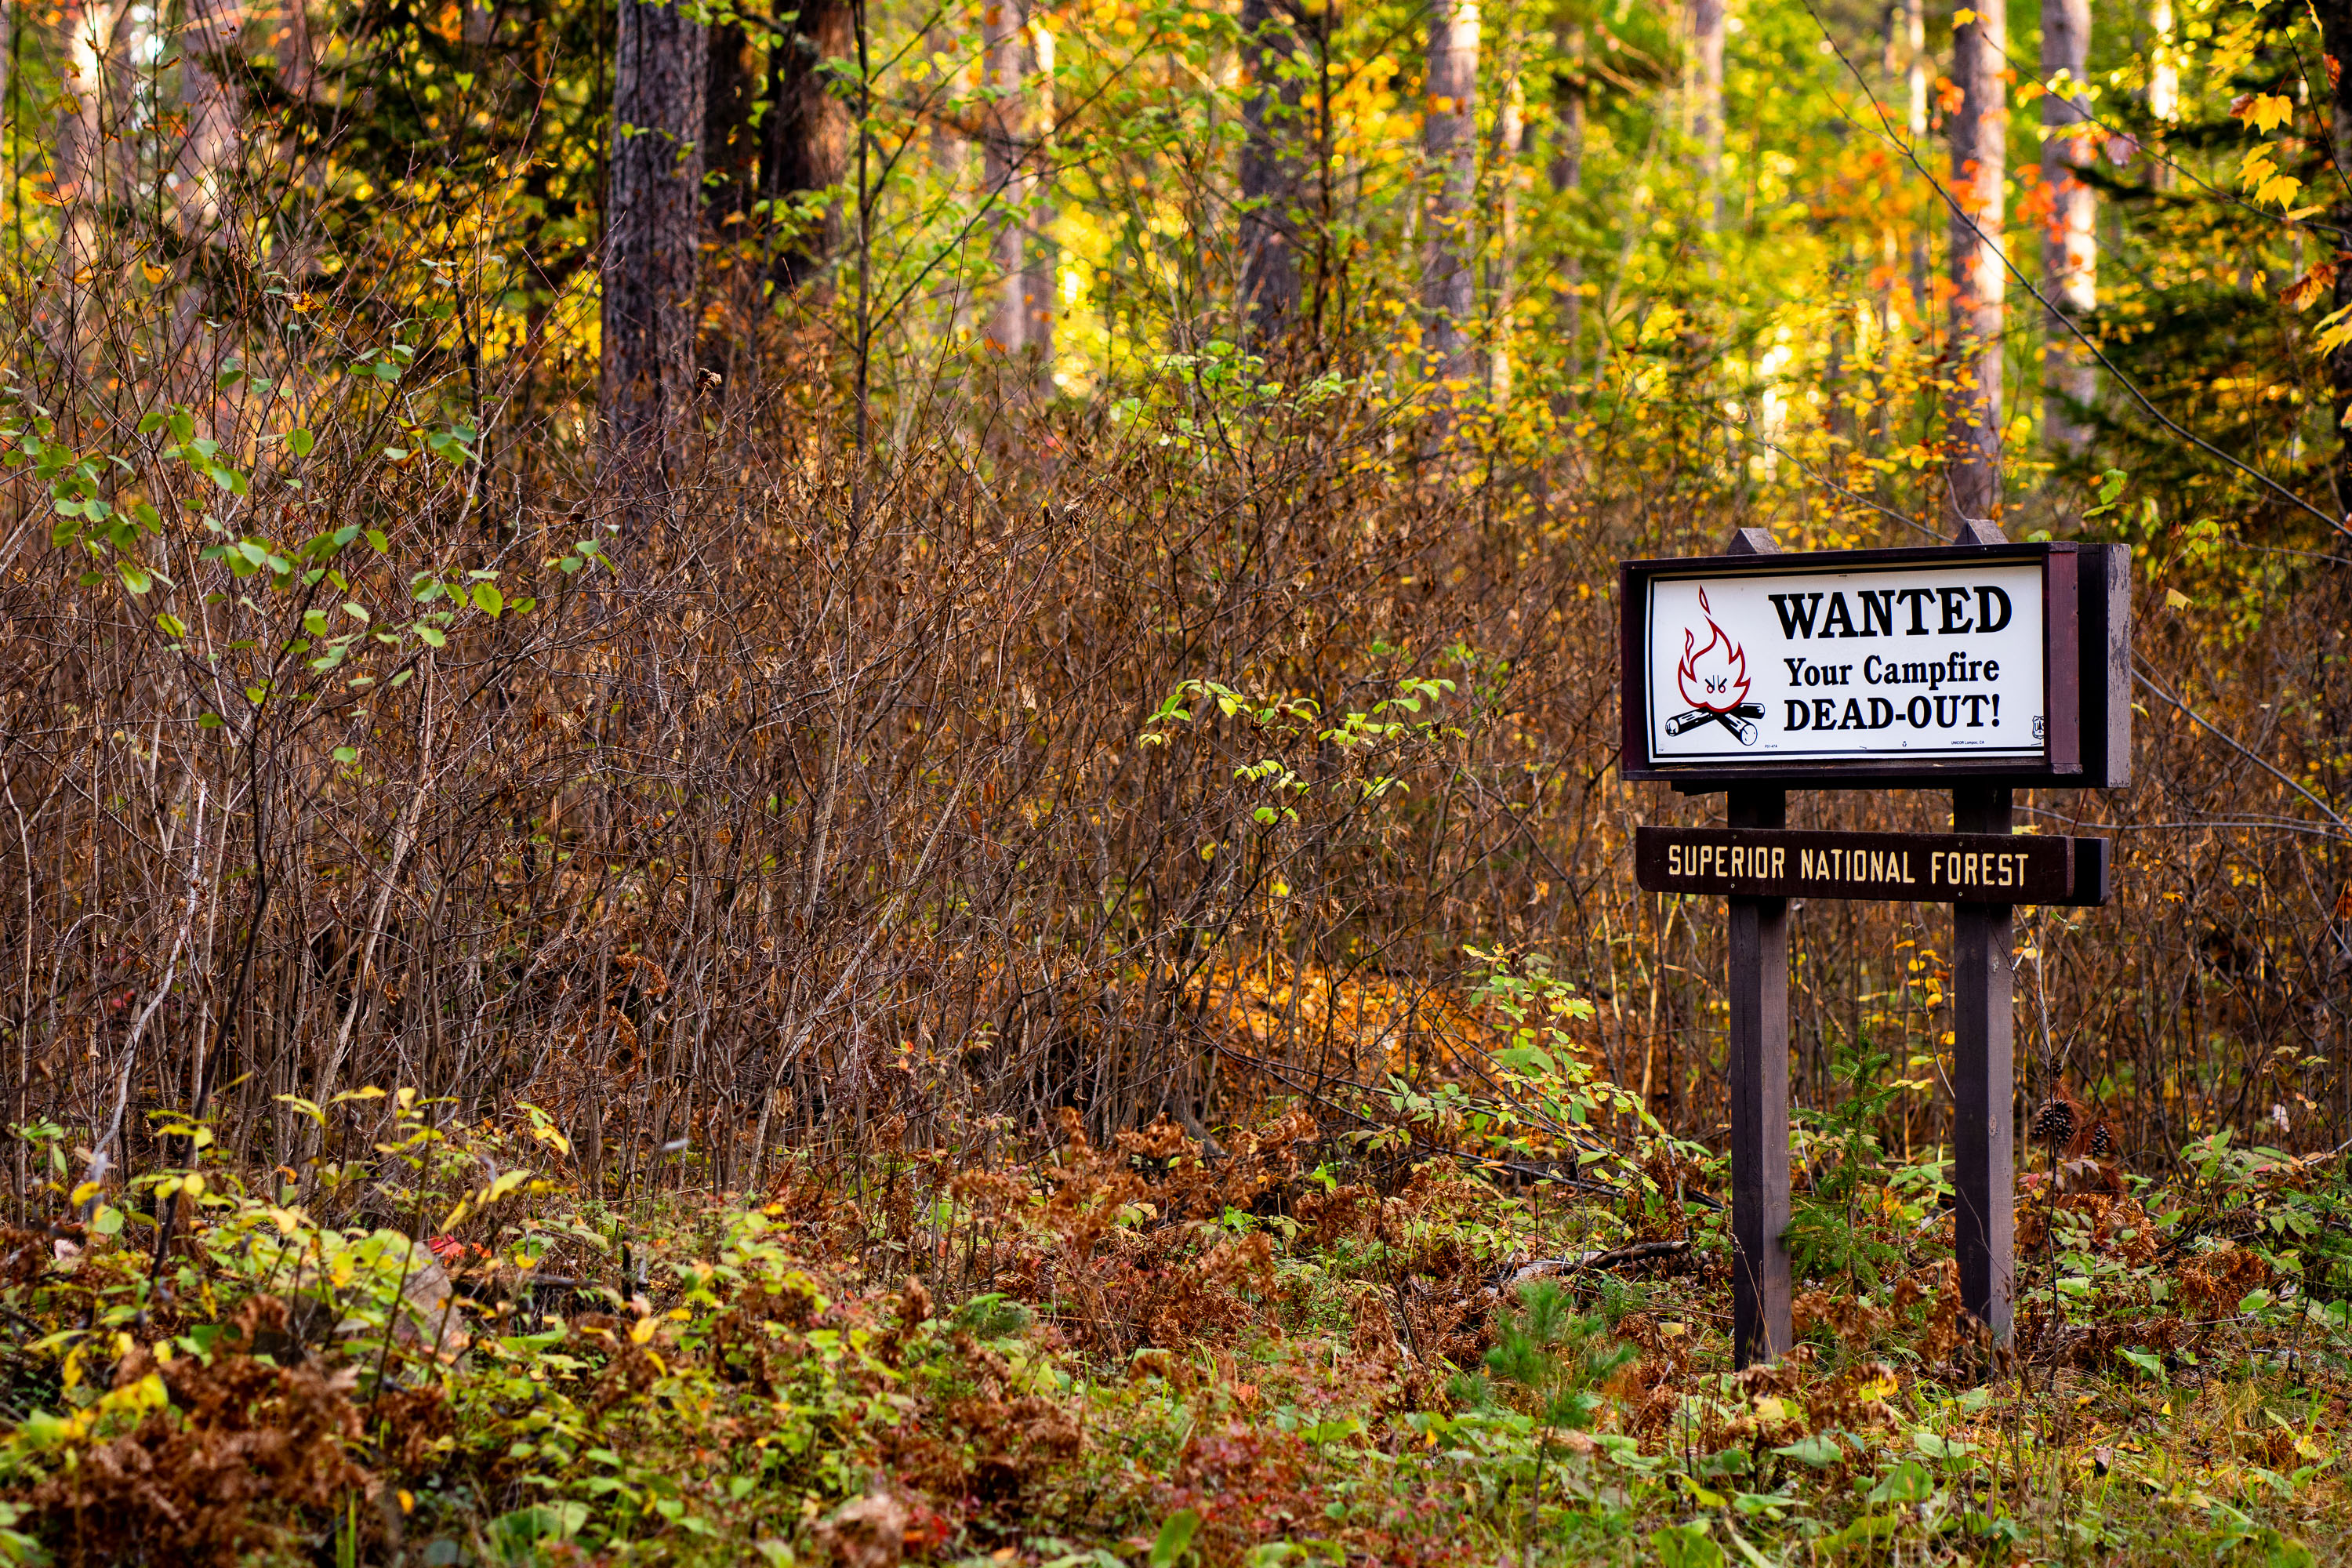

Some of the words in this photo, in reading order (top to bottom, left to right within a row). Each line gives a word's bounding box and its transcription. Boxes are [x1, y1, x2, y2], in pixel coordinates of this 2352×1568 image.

[1768, 586, 2013, 641] WANTED
[1784, 657, 1853, 687] Your
[1864, 651, 2000, 691] Campfire
[1784, 693, 2000, 731] DEAD-OUT!
[1668, 844, 1785, 879] SUPERIOR
[1801, 848, 1916, 884] NATIONAL
[1931, 851, 2029, 887] FOREST
